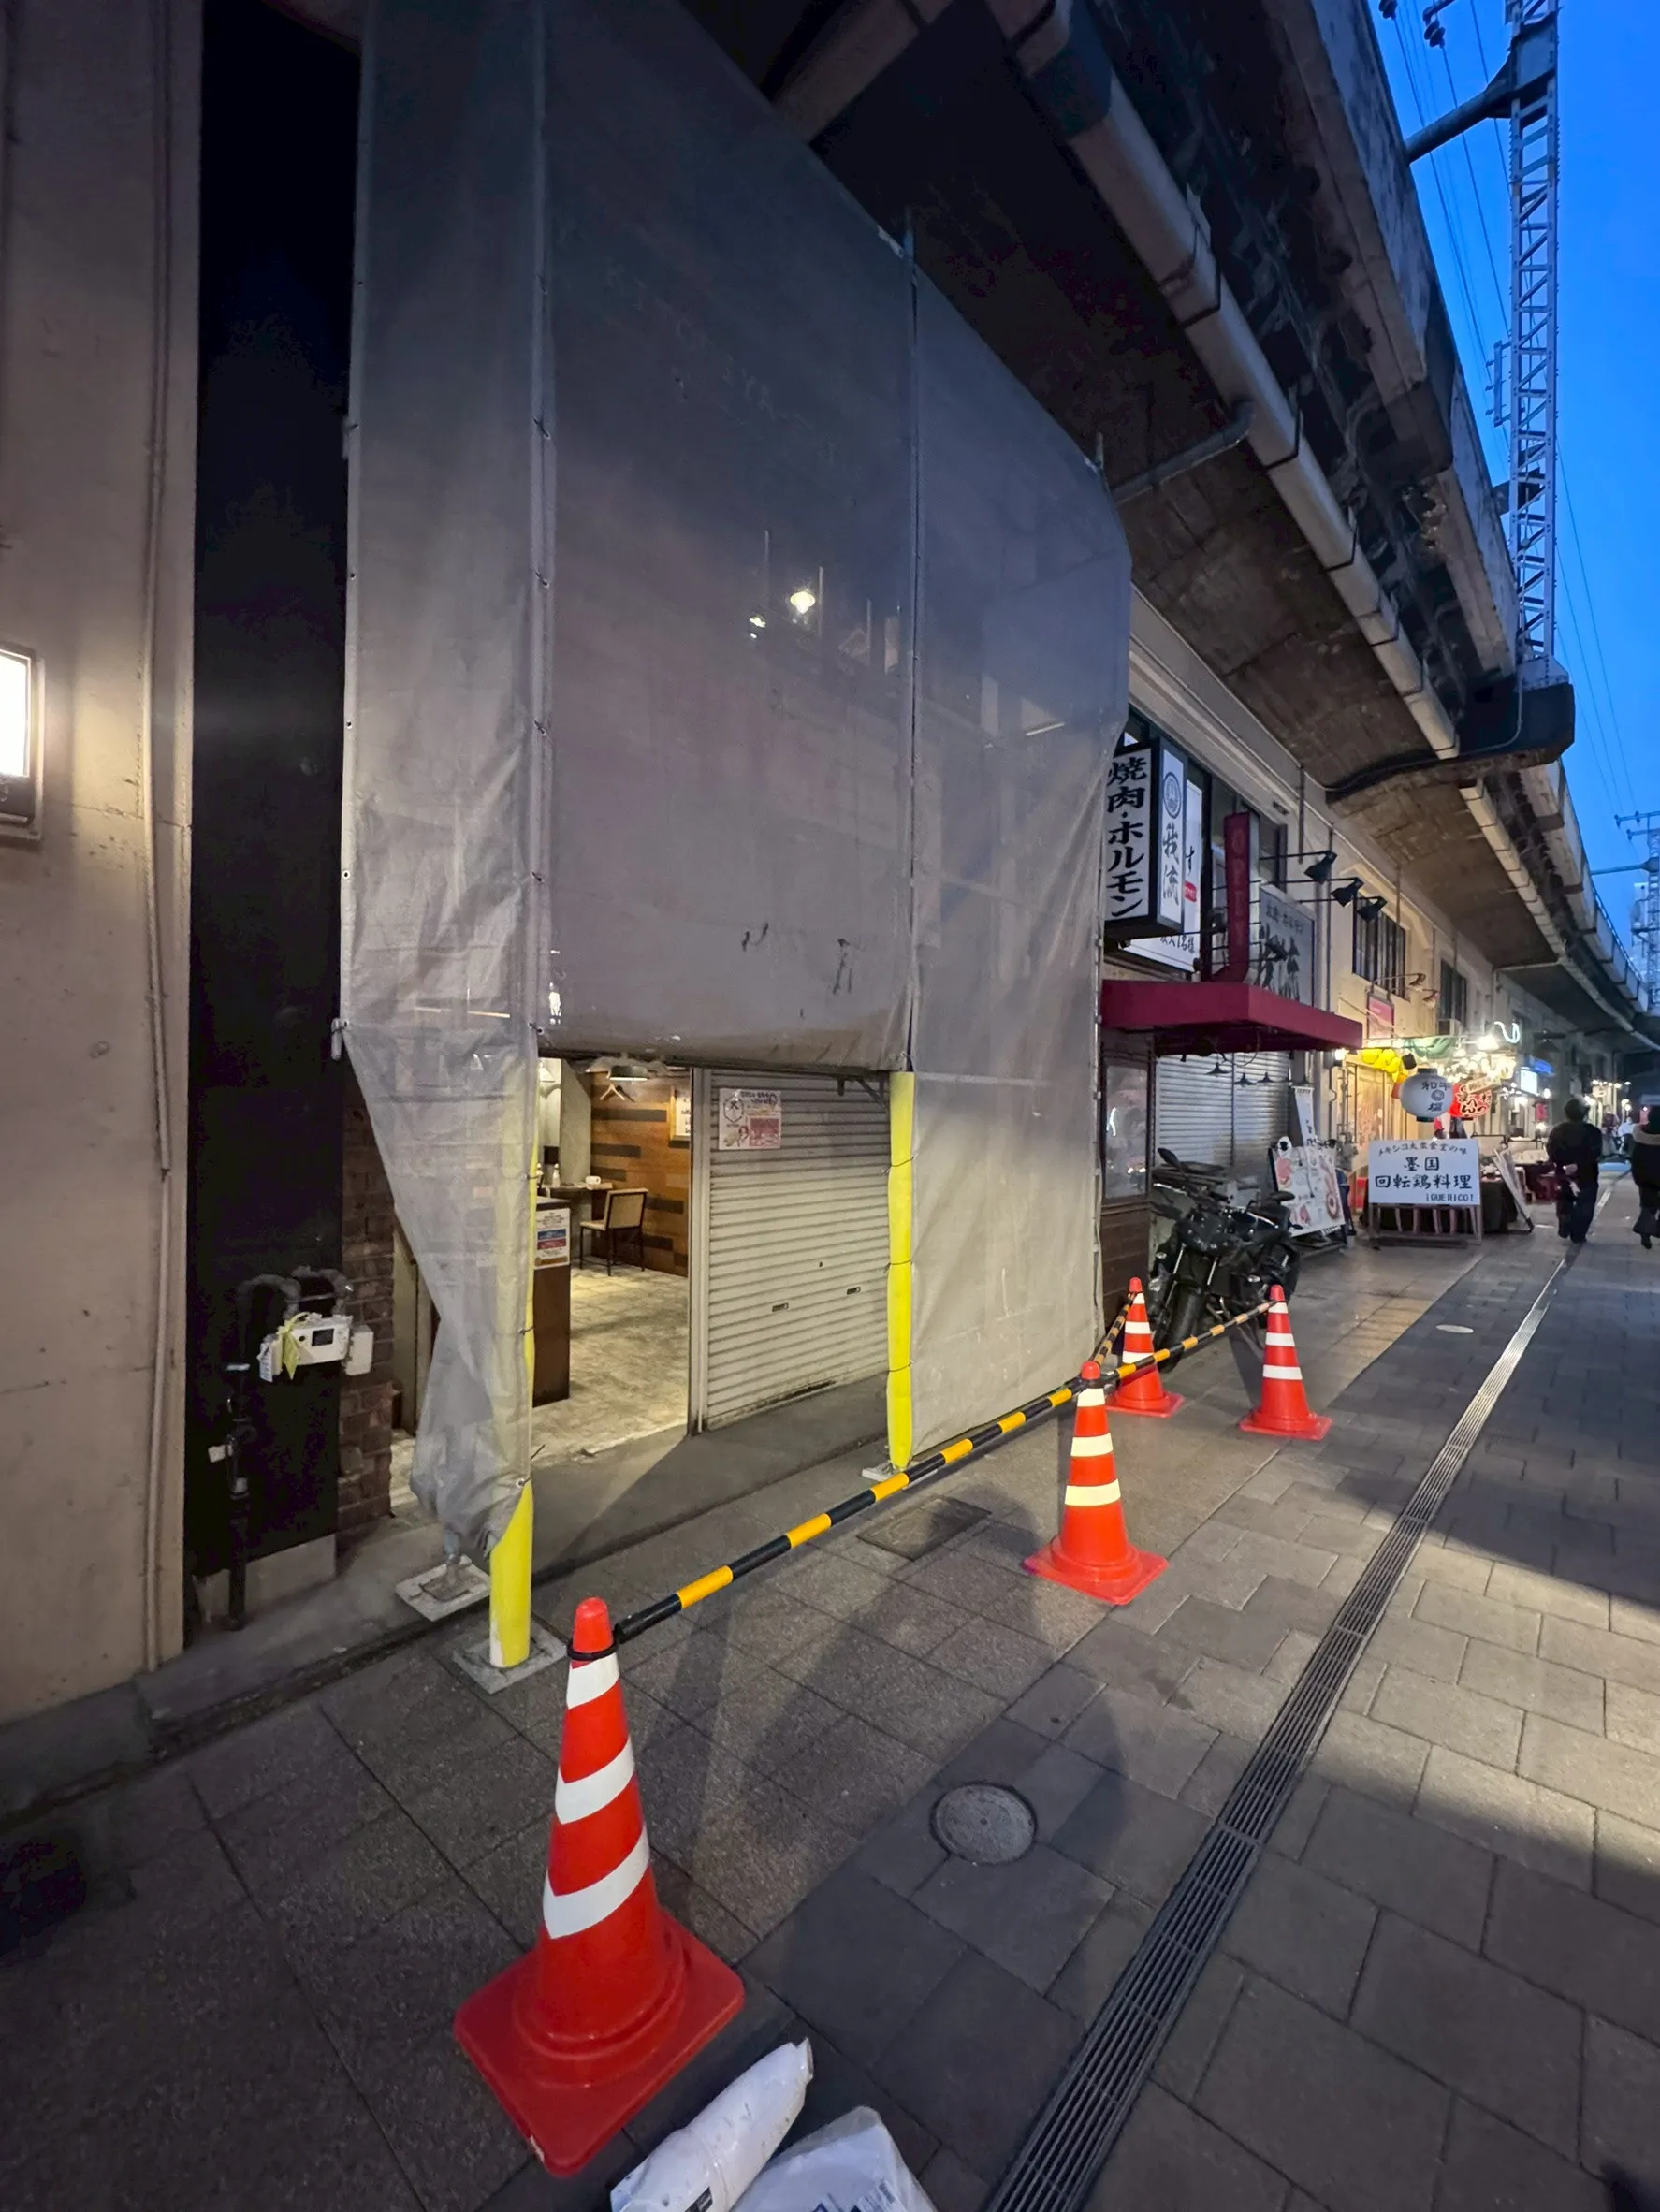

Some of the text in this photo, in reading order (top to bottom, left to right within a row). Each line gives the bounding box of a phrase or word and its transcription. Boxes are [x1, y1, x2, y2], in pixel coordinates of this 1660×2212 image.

[1106, 756, 1148, 918] 焼肉・ホルモン
[1375, 1173, 1473, 1189] 回転鶏料理
